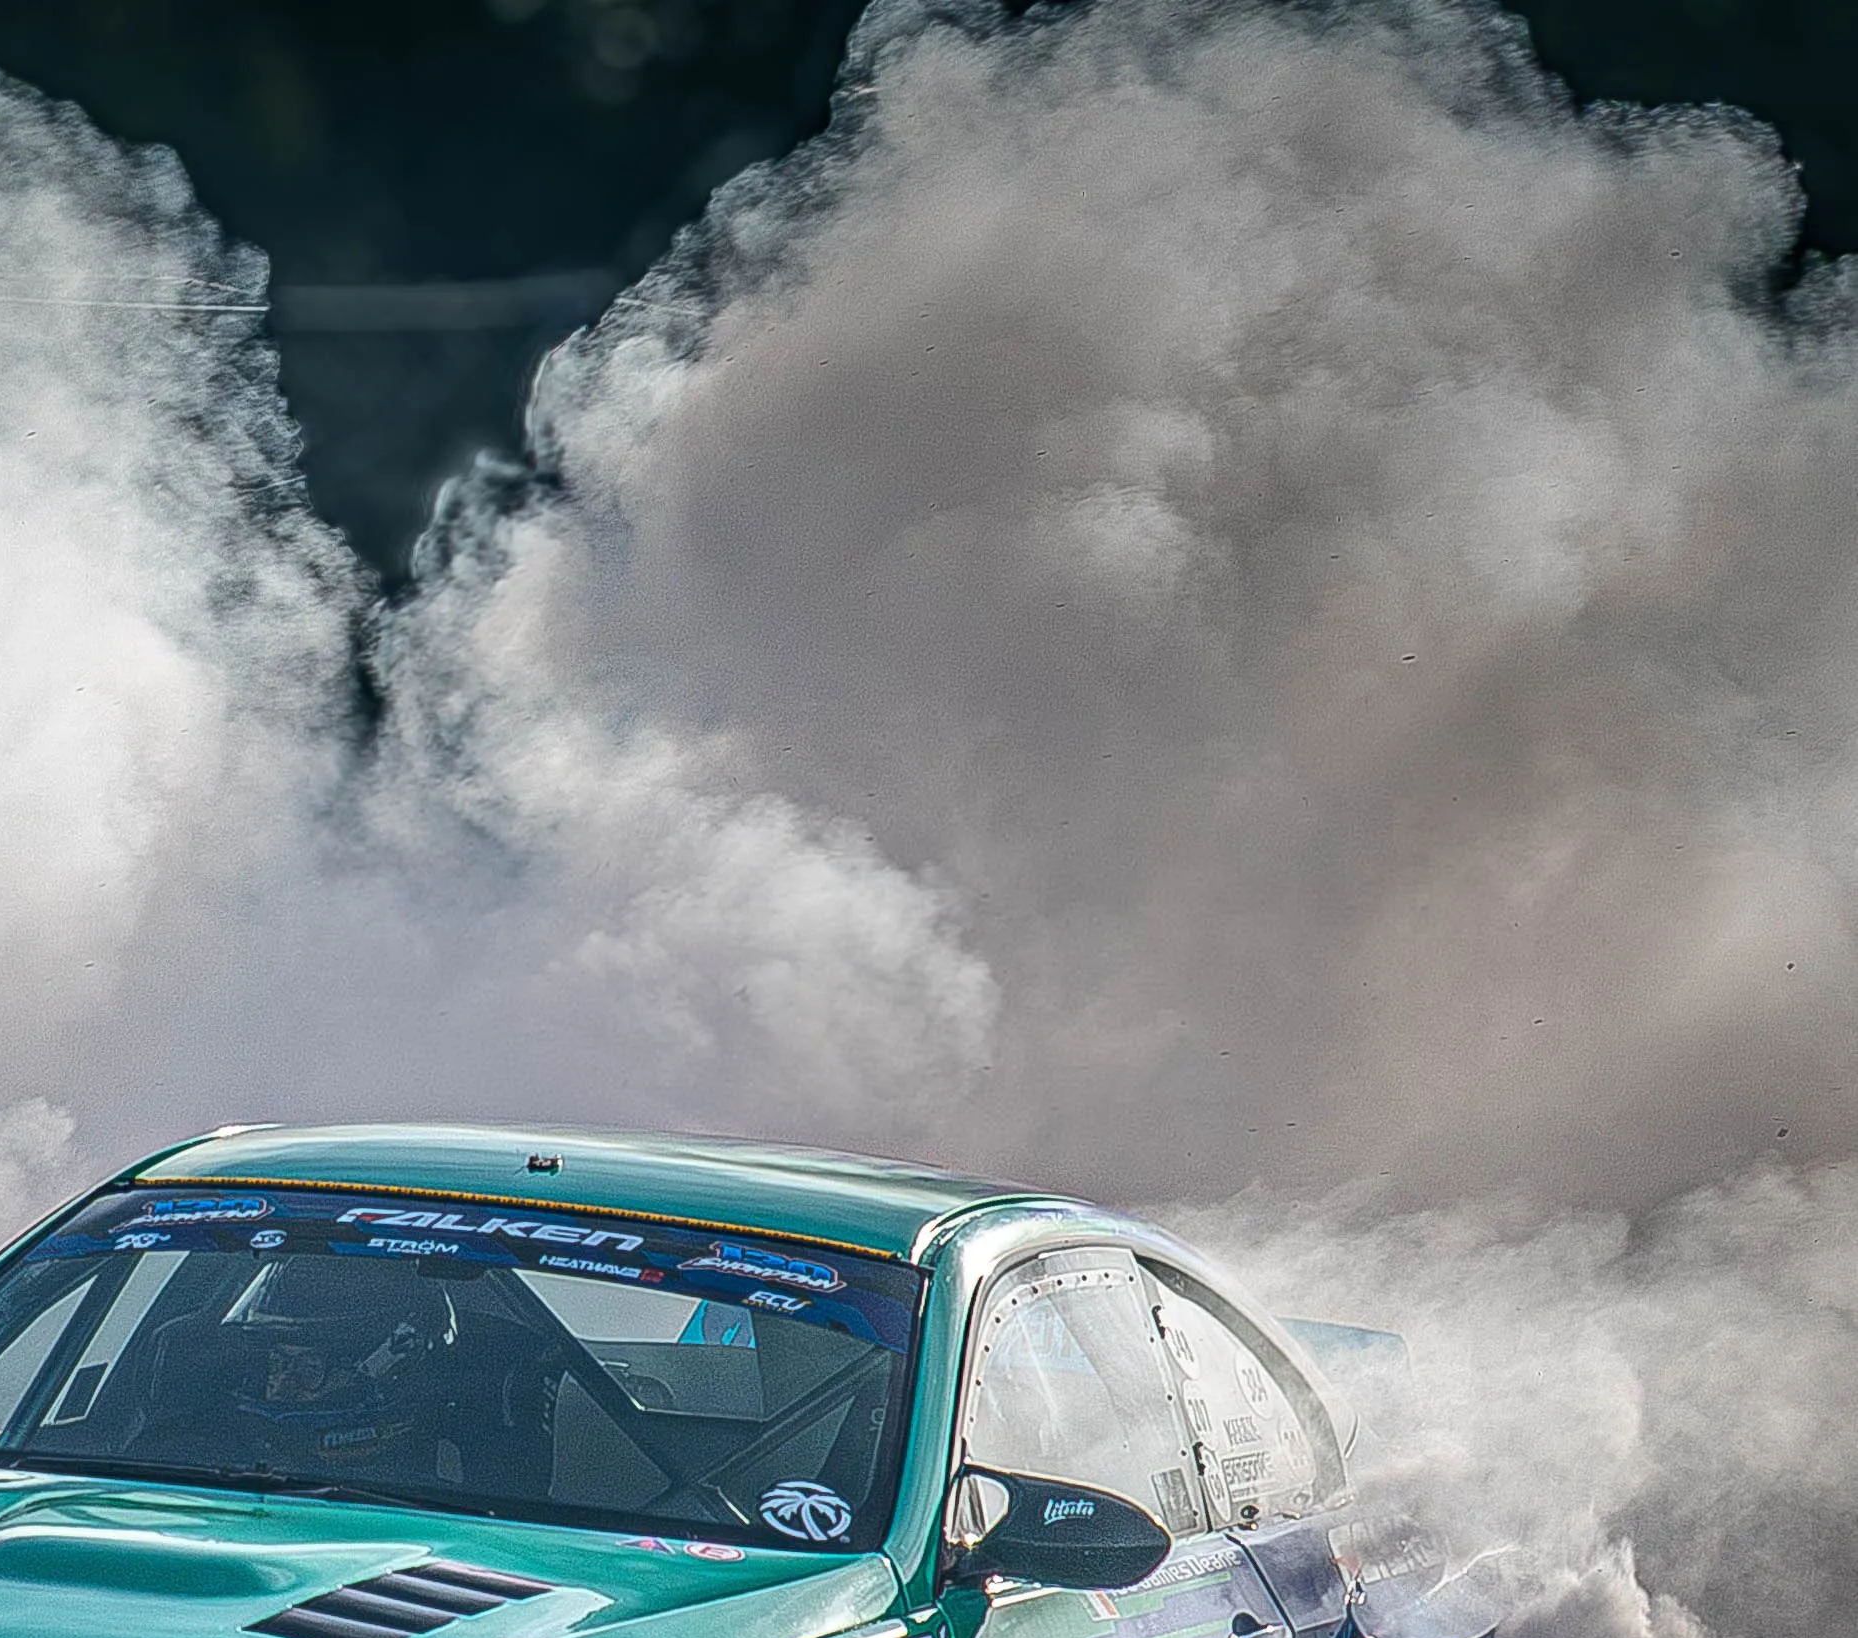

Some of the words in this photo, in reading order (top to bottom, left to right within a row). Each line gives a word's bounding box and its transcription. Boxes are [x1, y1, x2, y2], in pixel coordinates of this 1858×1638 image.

[335, 1206, 645, 1251] FALKEN
[366, 1238, 460, 1255] STRÖM
[539, 1253, 641, 1280] HEATWAVE
[748, 1290, 809, 1311] ECU
[1188, 1550, 1241, 1575] Deane
